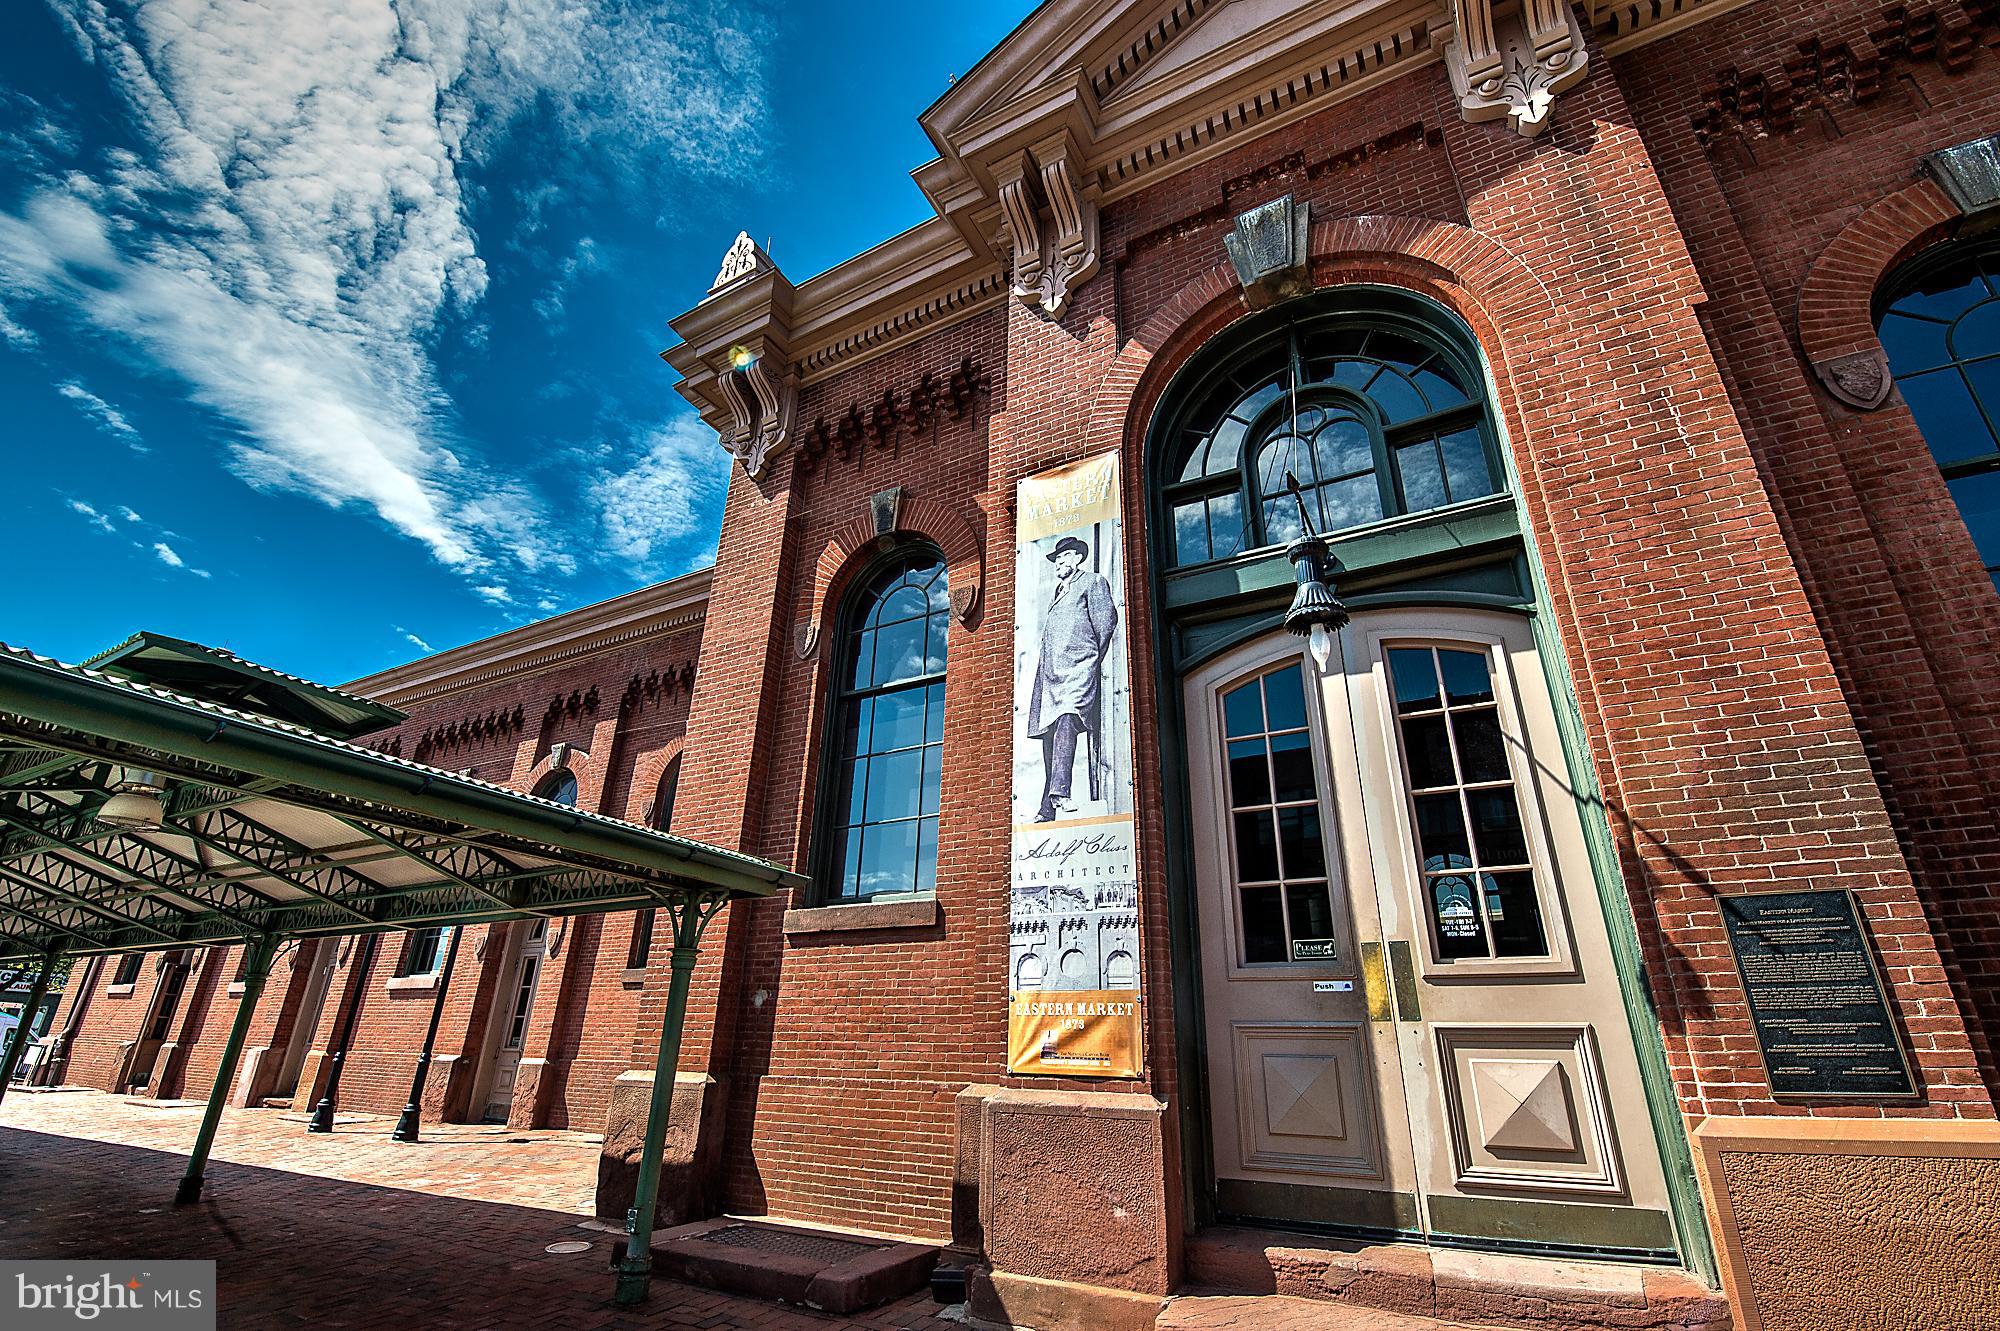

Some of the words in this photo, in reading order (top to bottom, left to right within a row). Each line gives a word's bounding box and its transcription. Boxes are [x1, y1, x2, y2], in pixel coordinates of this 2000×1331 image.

[1027, 482, 1111, 521] MARKET
[1018, 838, 1083, 865] Adolf
[1018, 864, 1129, 881] ARCHITECT
[1295, 942, 1323, 951] PLEASE
[1016, 1002, 1073, 1017] EASTERN
[1077, 1002, 1134, 1016] MARKET
[1060, 1018, 1085, 1031] 1873
